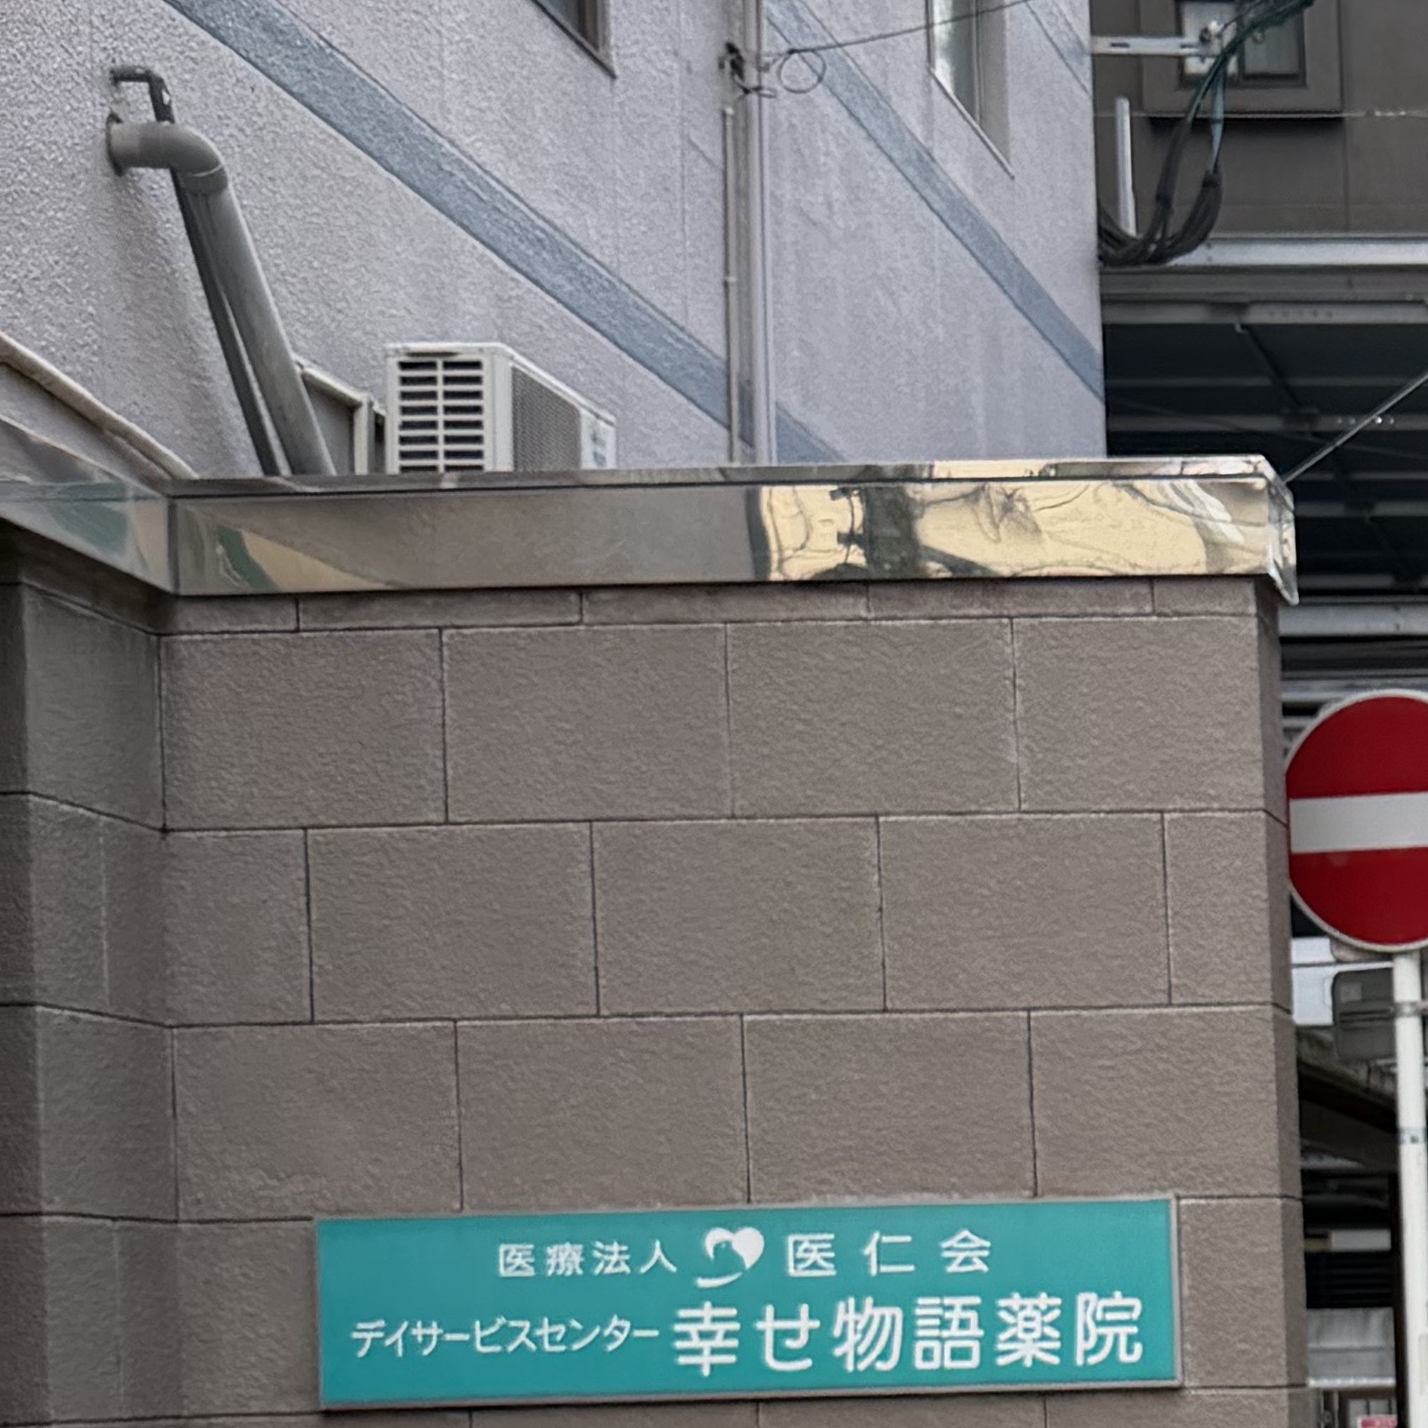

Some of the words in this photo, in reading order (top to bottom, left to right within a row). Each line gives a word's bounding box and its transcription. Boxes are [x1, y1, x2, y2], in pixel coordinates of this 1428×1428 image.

[498, 1239, 678, 1278] 医療法人
[785, 1228, 992, 1278] 医仁会
[351, 1314, 661, 1359] デイサービスセンター
[673, 1290, 1144, 1378] 幸せ物語薬院
